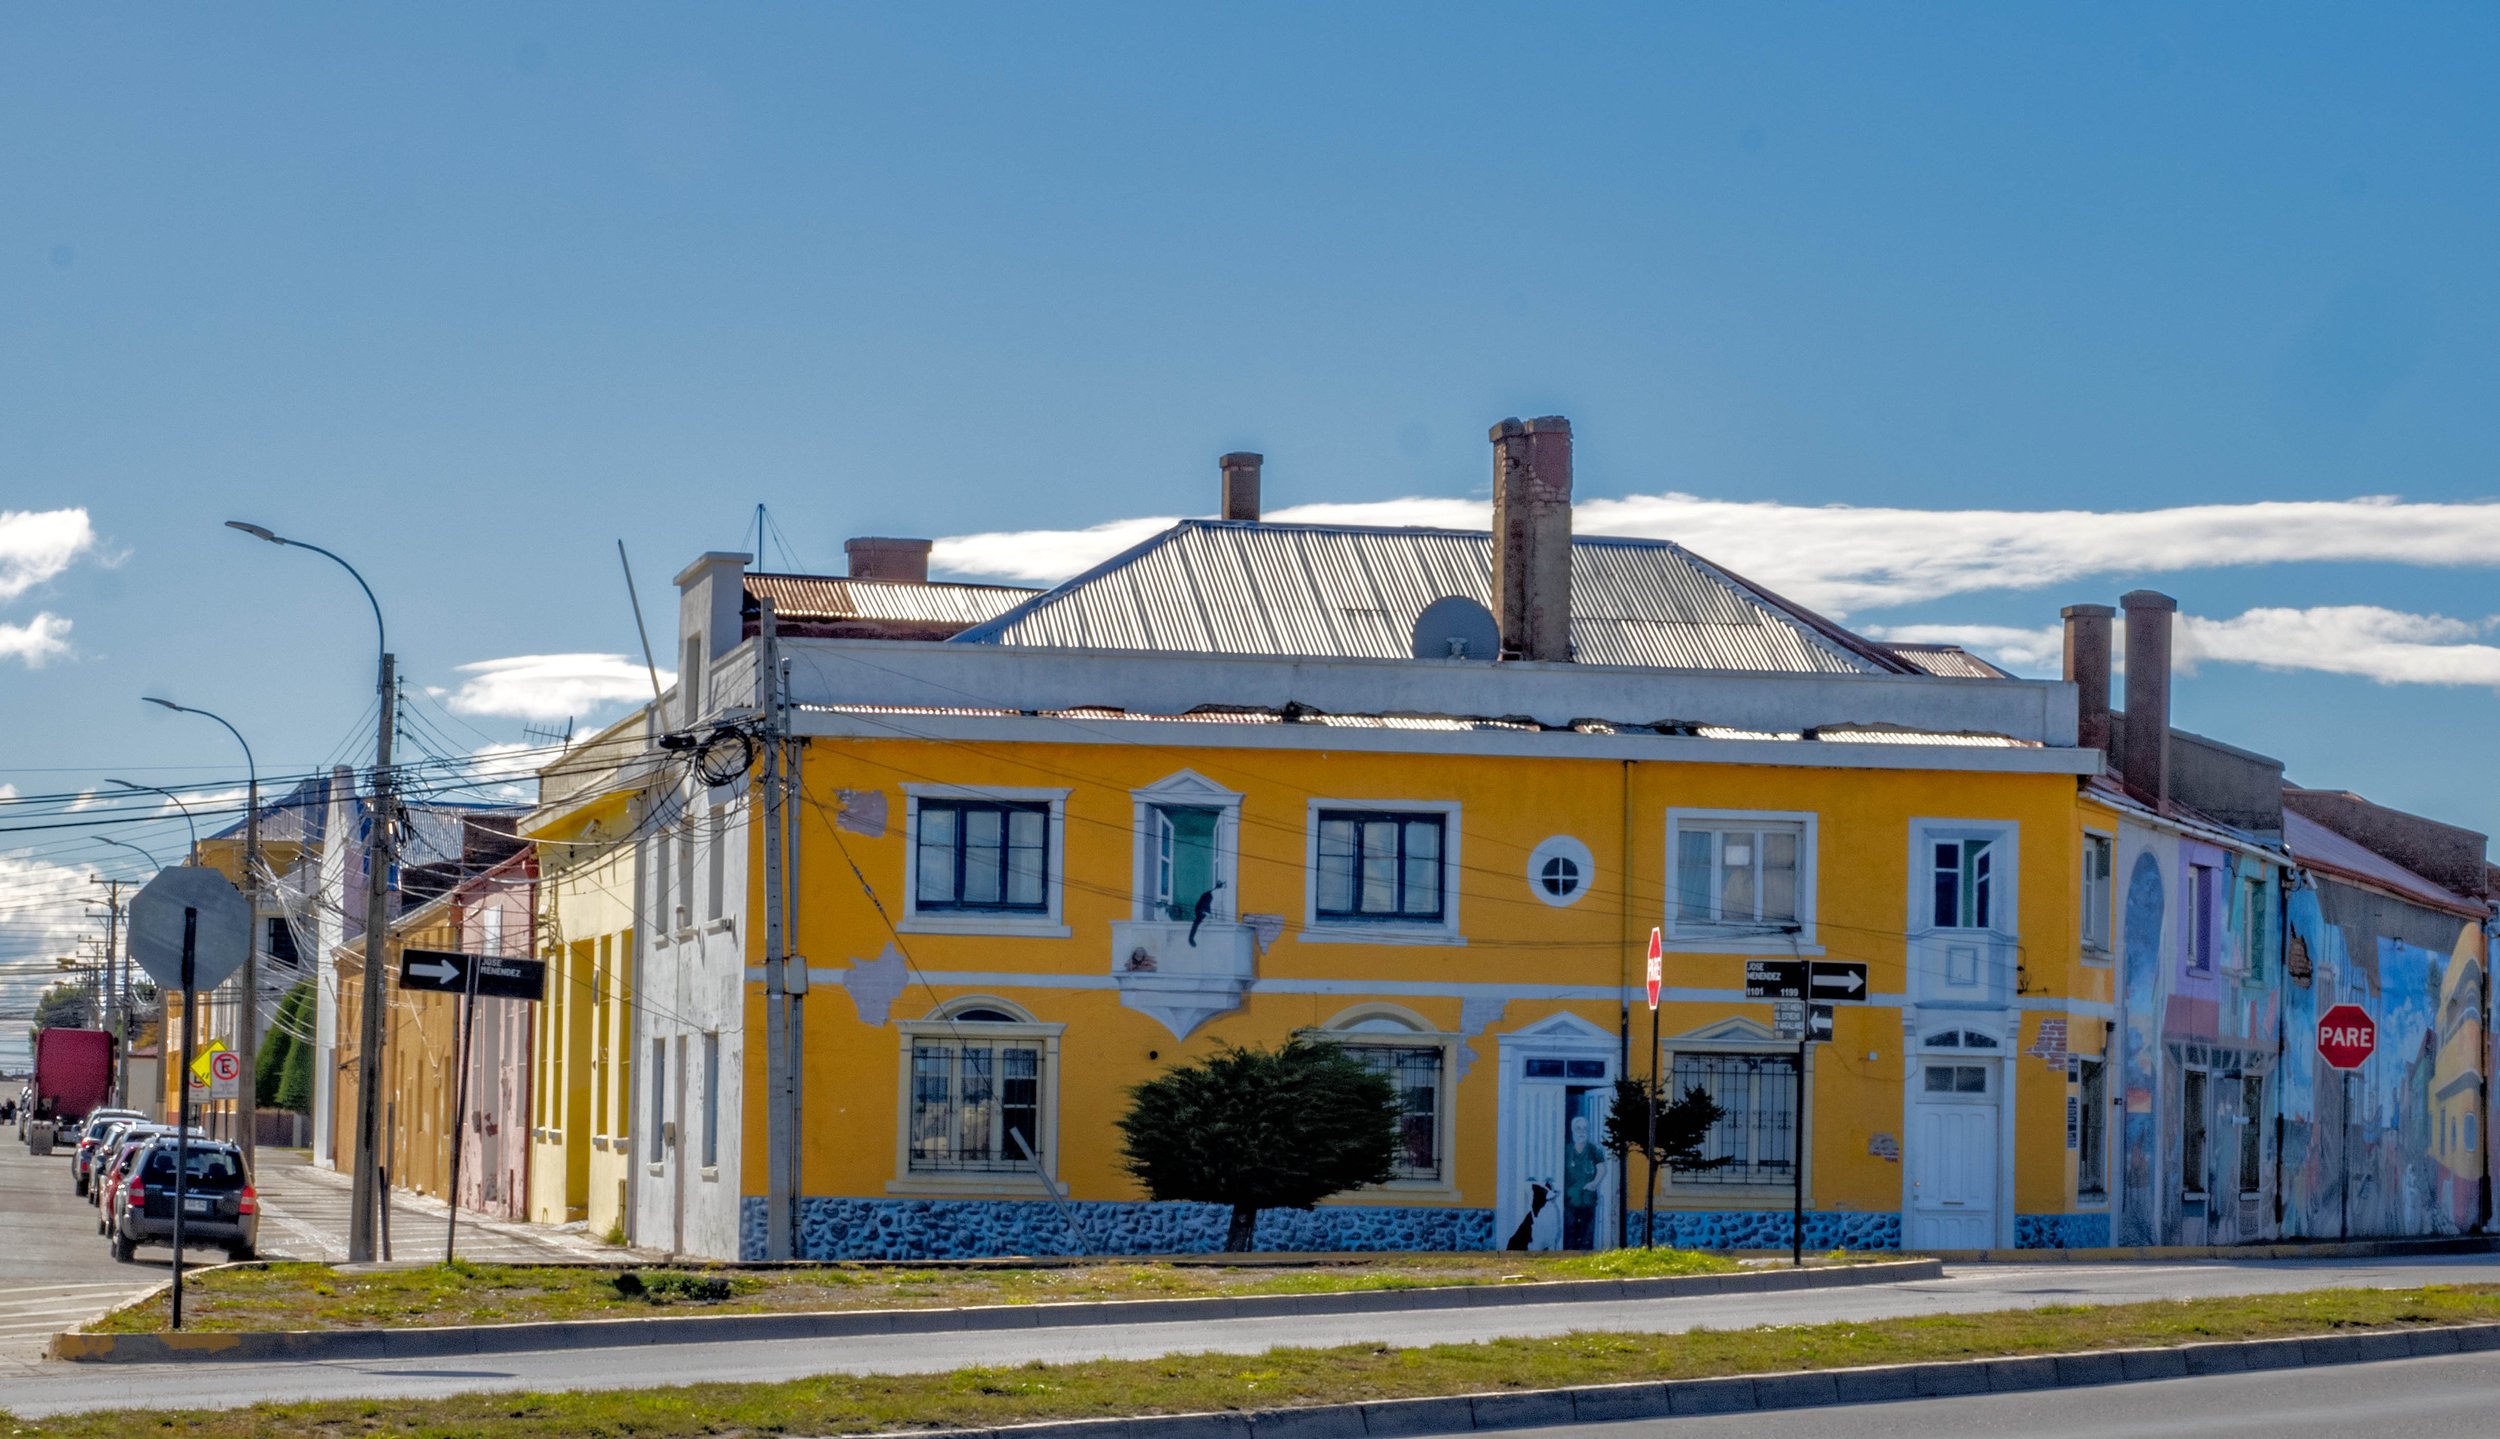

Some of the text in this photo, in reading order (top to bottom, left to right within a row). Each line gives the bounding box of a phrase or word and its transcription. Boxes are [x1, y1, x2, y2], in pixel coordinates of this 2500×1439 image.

[482, 958, 503, 967] JOSE
[1748, 962, 1765, 971] JOSE
[480, 966, 521, 978] MENENDEZ
[1747, 971, 1782, 981] MENENDEZ
[1780, 987, 1799, 997] 1199
[2320, 1026, 2372, 1048] PARE
